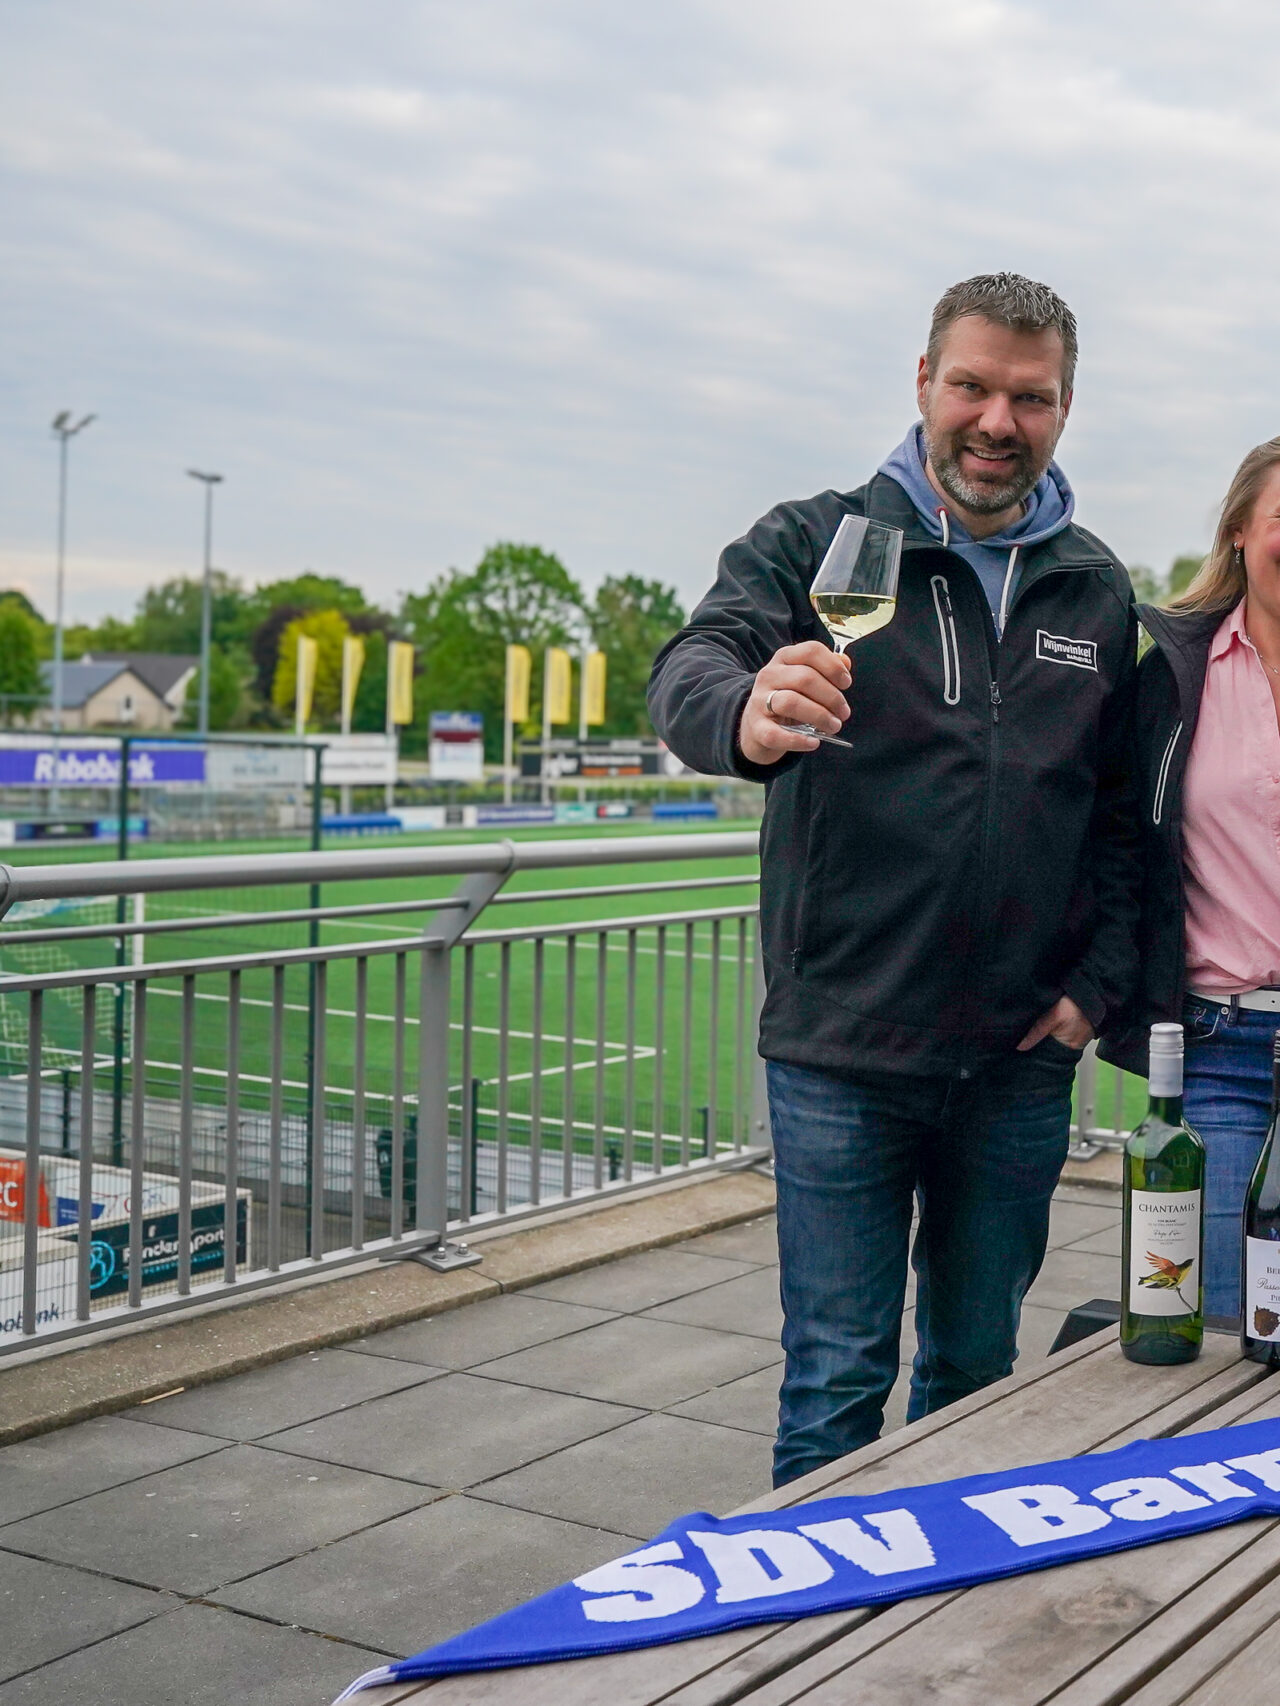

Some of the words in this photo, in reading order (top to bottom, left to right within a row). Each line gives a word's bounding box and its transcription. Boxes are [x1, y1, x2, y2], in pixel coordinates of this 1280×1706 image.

[1043, 637, 1092, 658] Wijnwinkel
[1138, 1202, 1196, 1213] CHANTAMIS
[573, 1508, 937, 1623] SDV
